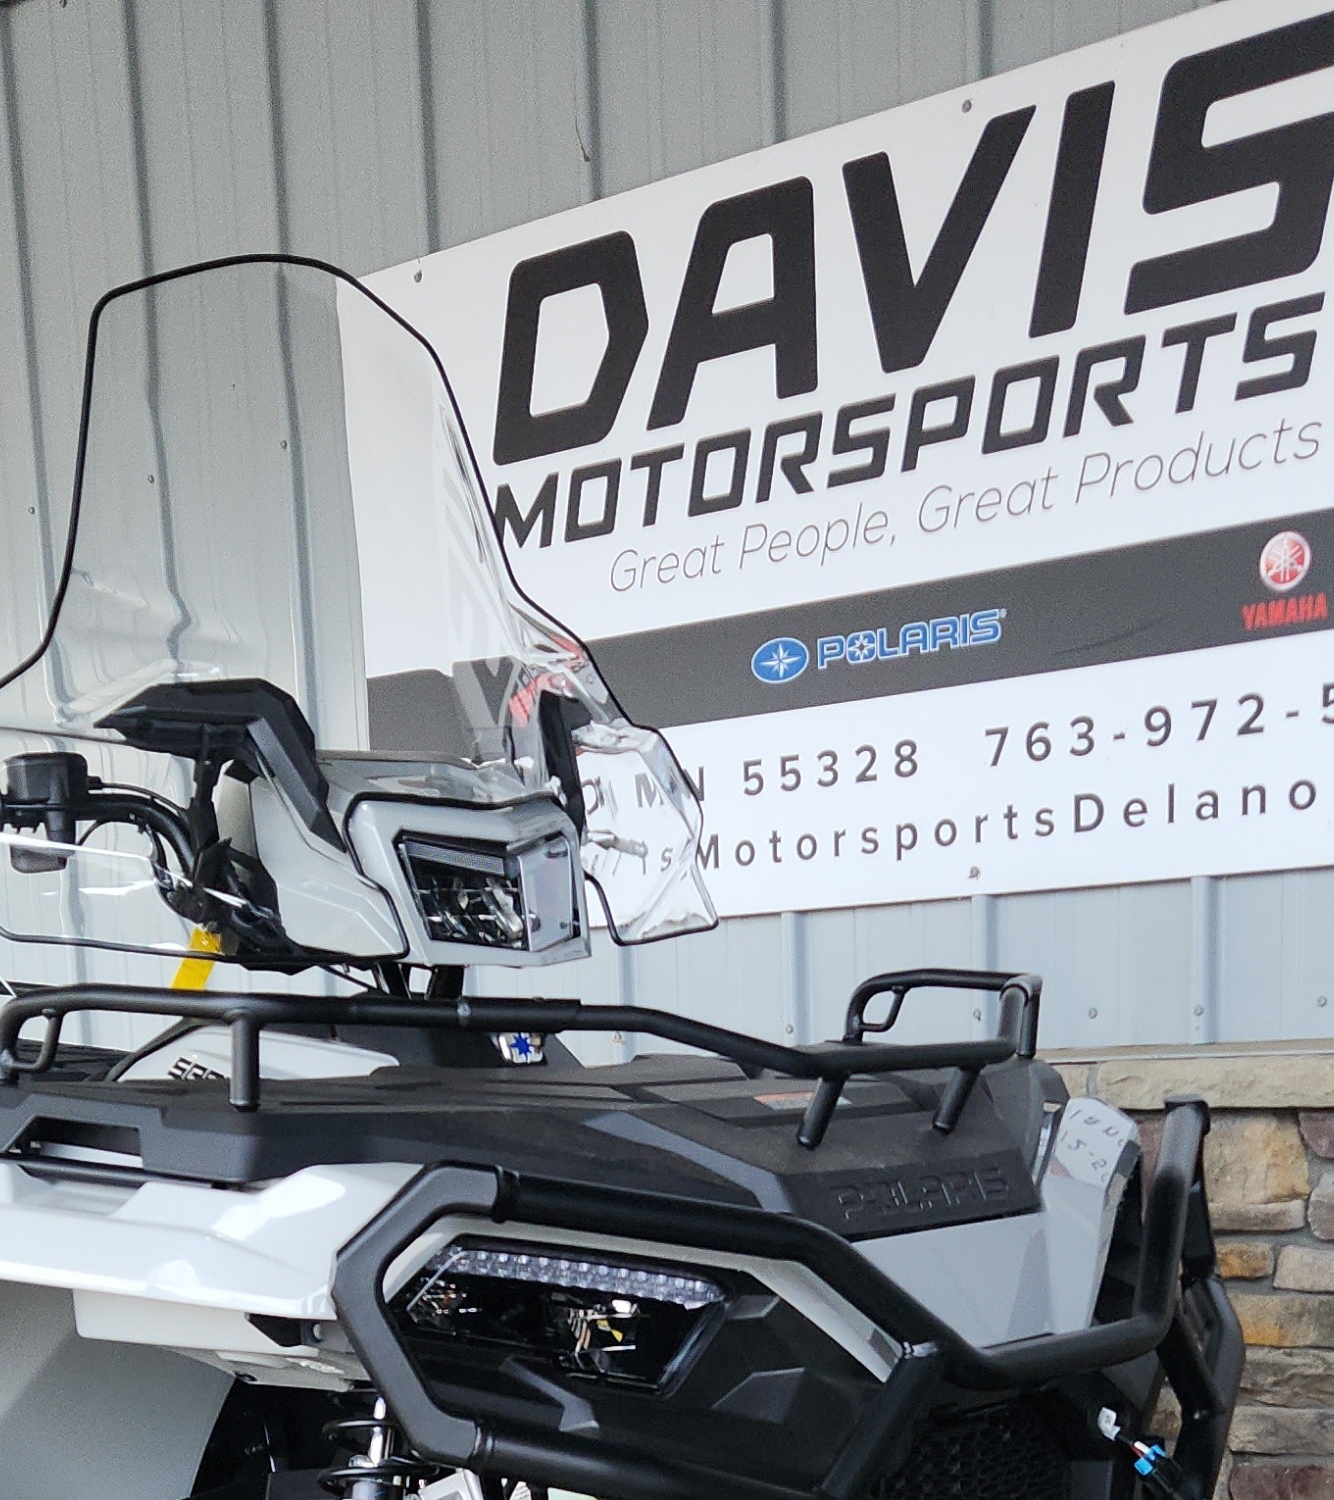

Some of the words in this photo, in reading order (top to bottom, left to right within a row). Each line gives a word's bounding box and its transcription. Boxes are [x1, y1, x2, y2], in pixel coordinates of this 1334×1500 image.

[493, 291, 1327, 549] MOTORSPORTS
[610, 535, 725, 592] Great
[739, 502, 896, 569] People,
[918, 466, 1058, 534] Great
[1074, 417, 1323, 504] Products
[817, 608, 1003, 670] POLARIS
[1241, 591, 1328, 631] YAMAHA
[742, 739, 918, 797] 55328
